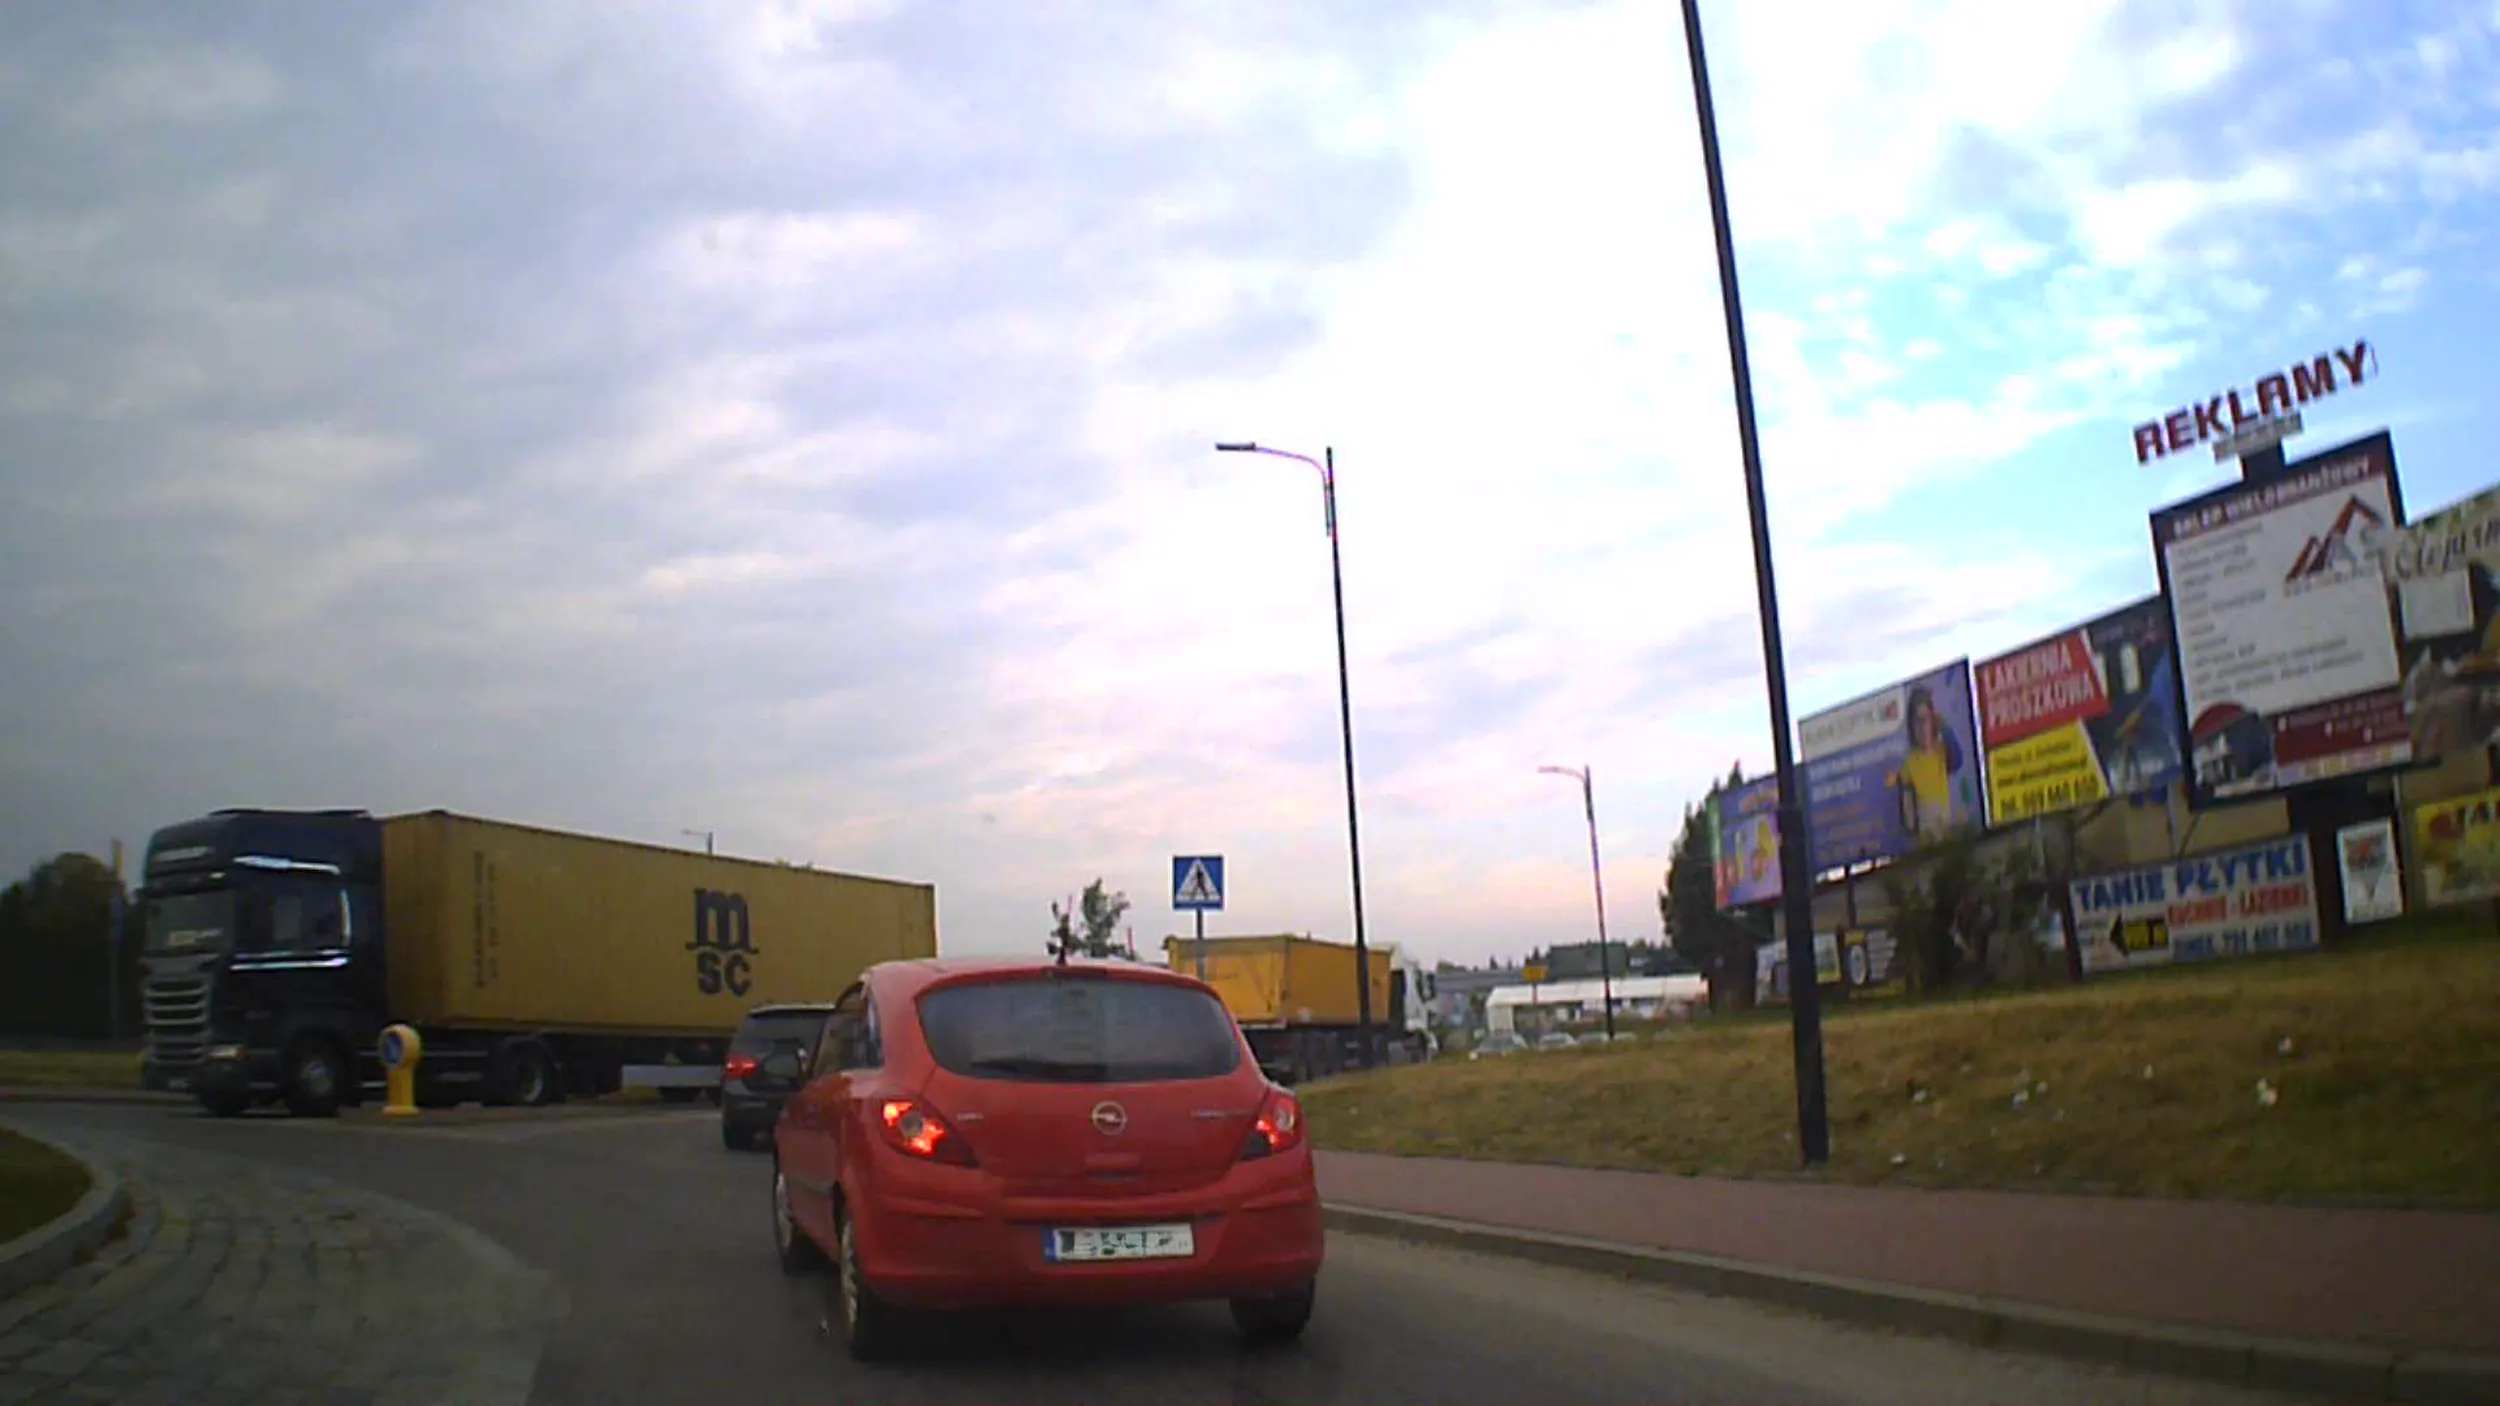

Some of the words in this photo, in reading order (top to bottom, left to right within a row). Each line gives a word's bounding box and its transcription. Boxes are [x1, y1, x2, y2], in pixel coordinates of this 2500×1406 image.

[2133, 340, 2367, 464] REKLAMY
[1983, 640, 2073, 694] LAKIERNIA
[1988, 672, 2096, 729] PROSZKOWA
[2075, 870, 2166, 912] TANIE
[2175, 838, 2309, 895] PŁYTKI
